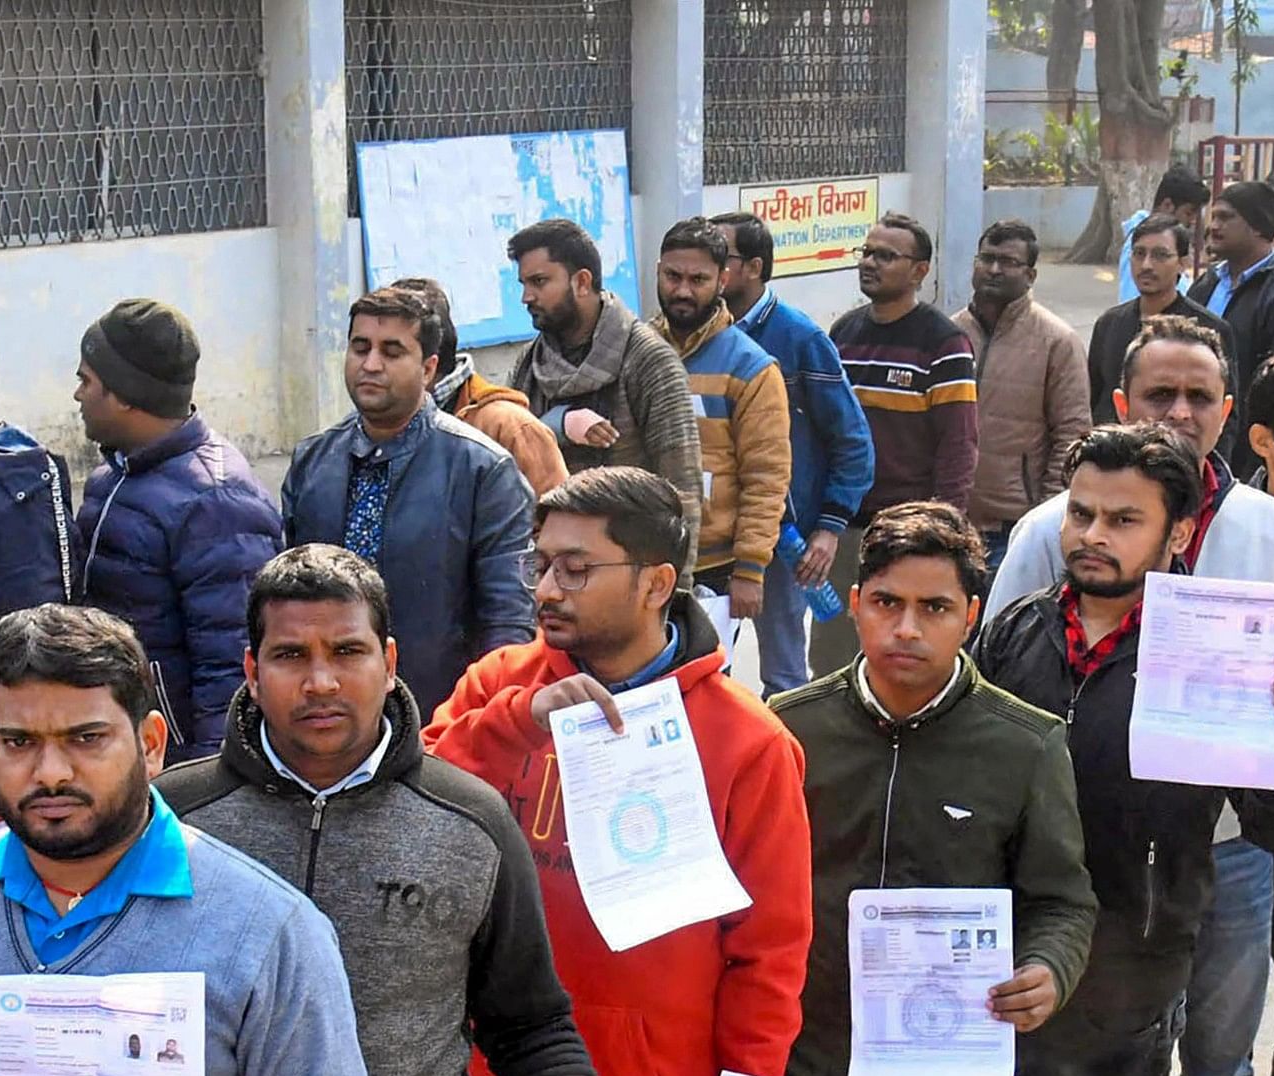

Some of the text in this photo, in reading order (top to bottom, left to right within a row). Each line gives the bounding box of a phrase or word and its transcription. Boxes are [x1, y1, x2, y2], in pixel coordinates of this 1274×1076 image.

[752, 184, 867, 222] परीक्षा विभाग
[773, 231, 809, 247] NATION
